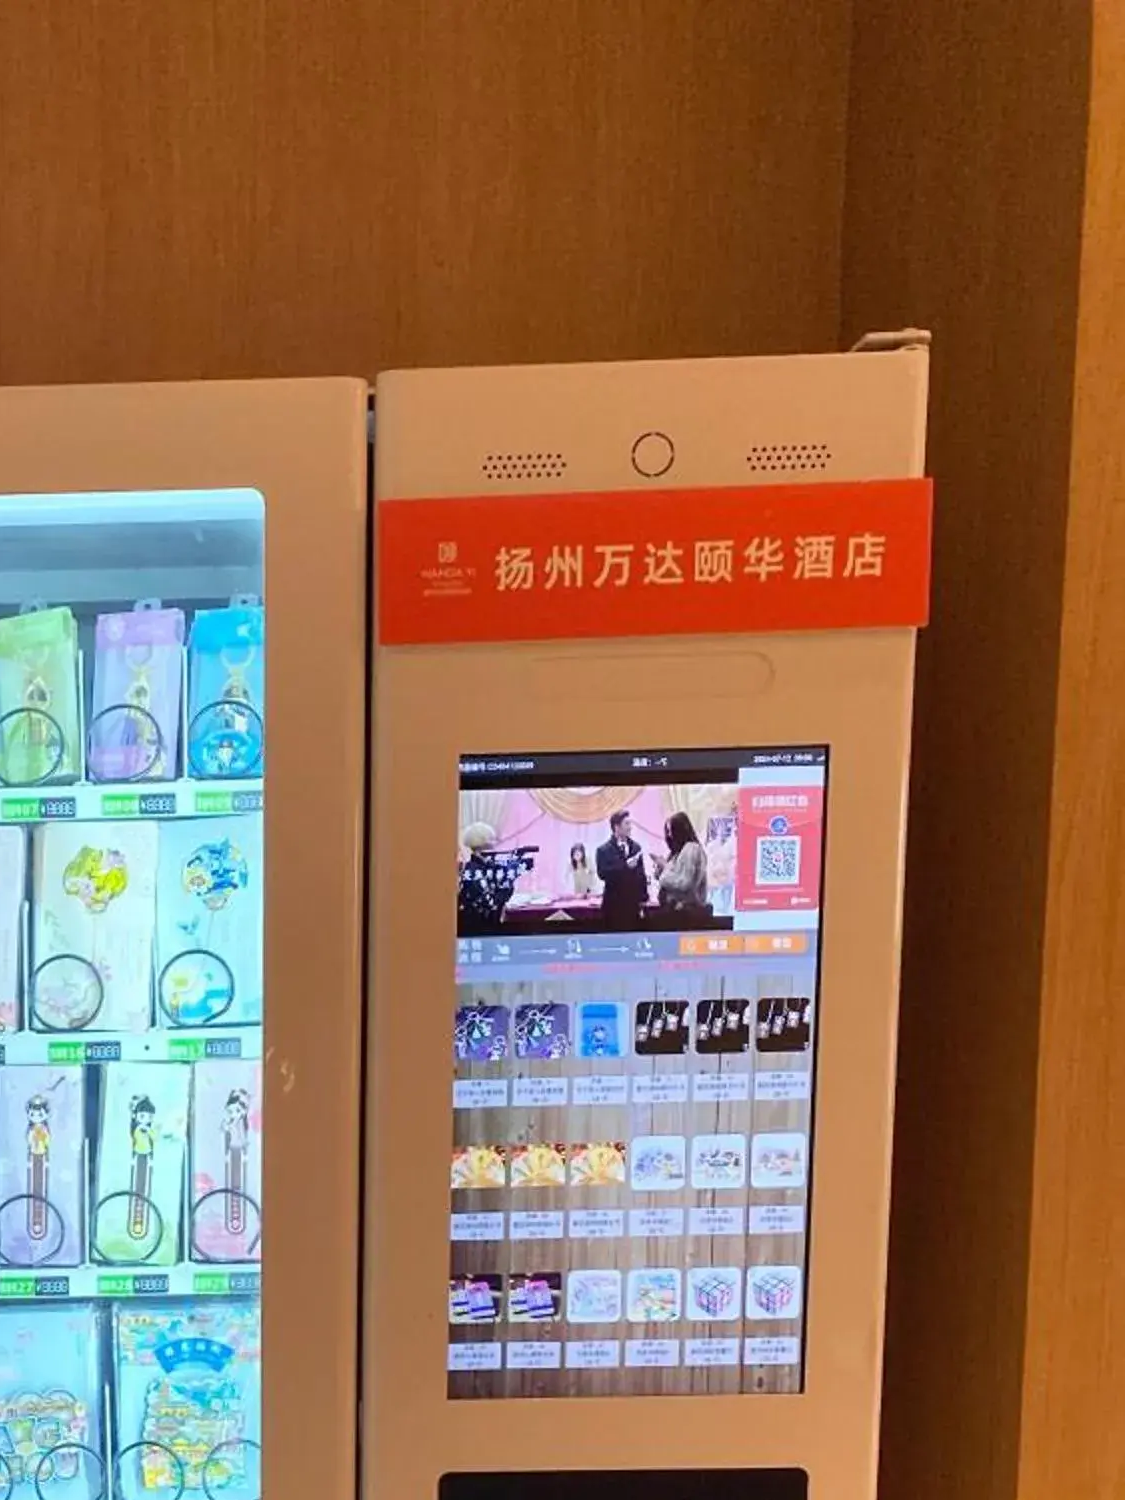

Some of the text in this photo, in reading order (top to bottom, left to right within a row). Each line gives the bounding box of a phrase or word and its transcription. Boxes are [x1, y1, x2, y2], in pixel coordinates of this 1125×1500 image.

[495, 533, 886, 590] 扬州万达颐华酒店
